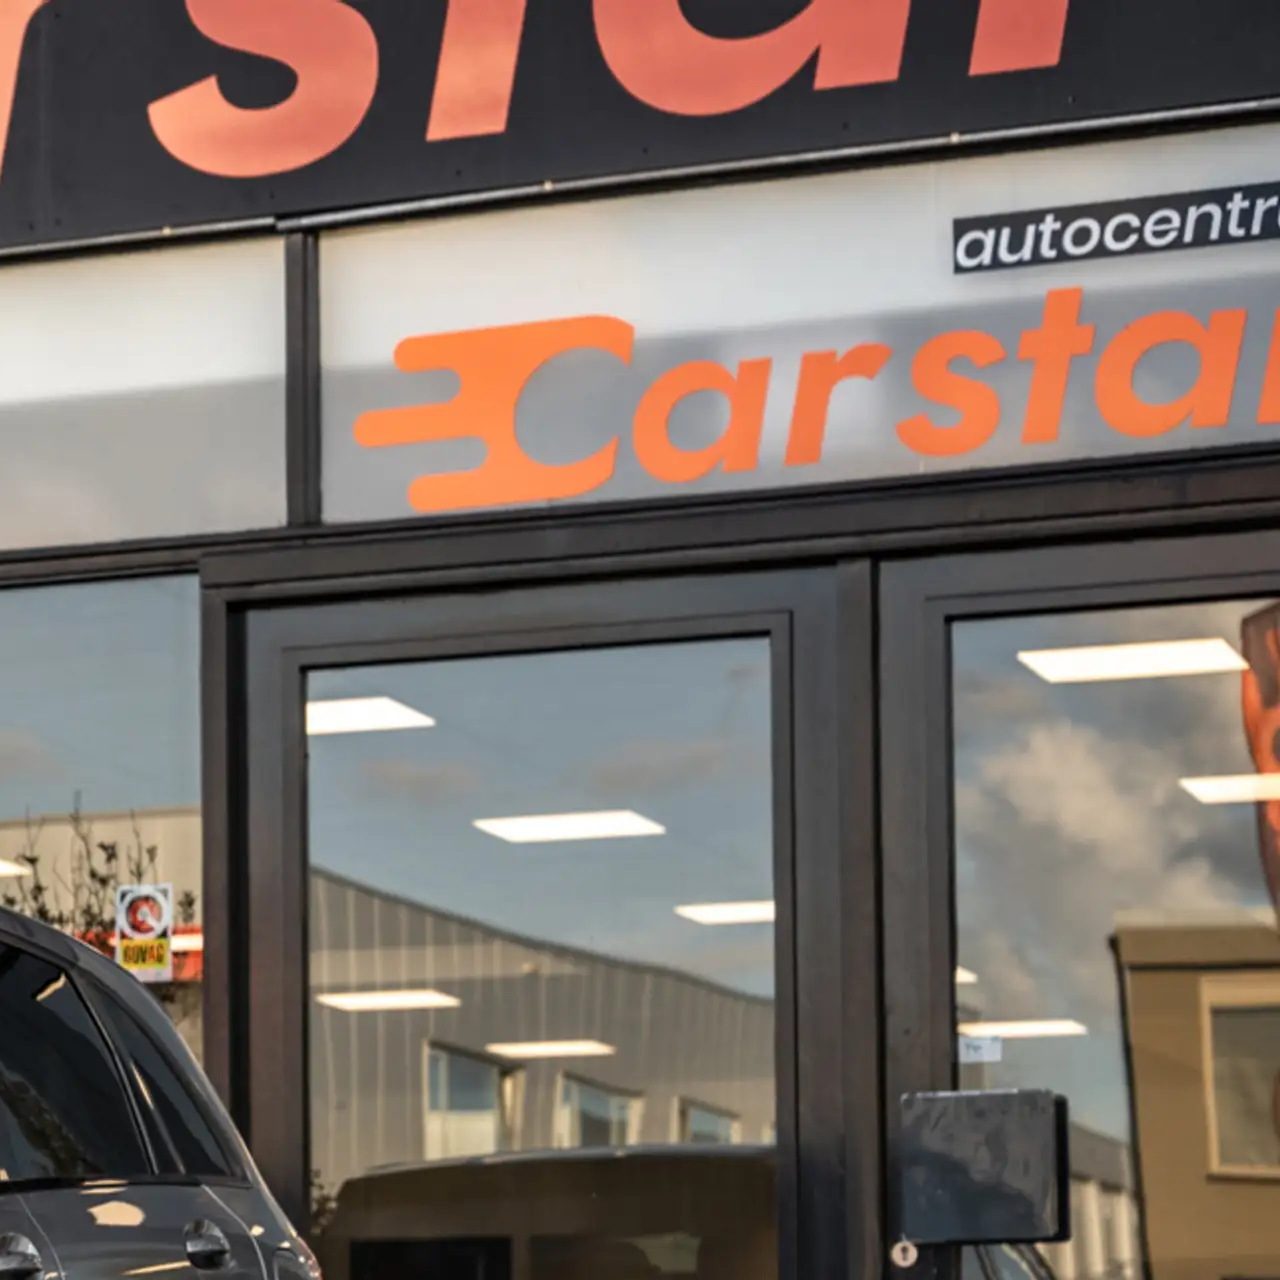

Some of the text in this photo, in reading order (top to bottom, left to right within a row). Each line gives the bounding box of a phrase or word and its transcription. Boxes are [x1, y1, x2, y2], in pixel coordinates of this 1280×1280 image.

[955, 191, 1280, 268] autocentr
[352, 286, 1280, 513] Carsta
[122, 944, 165, 965] BOVAG
